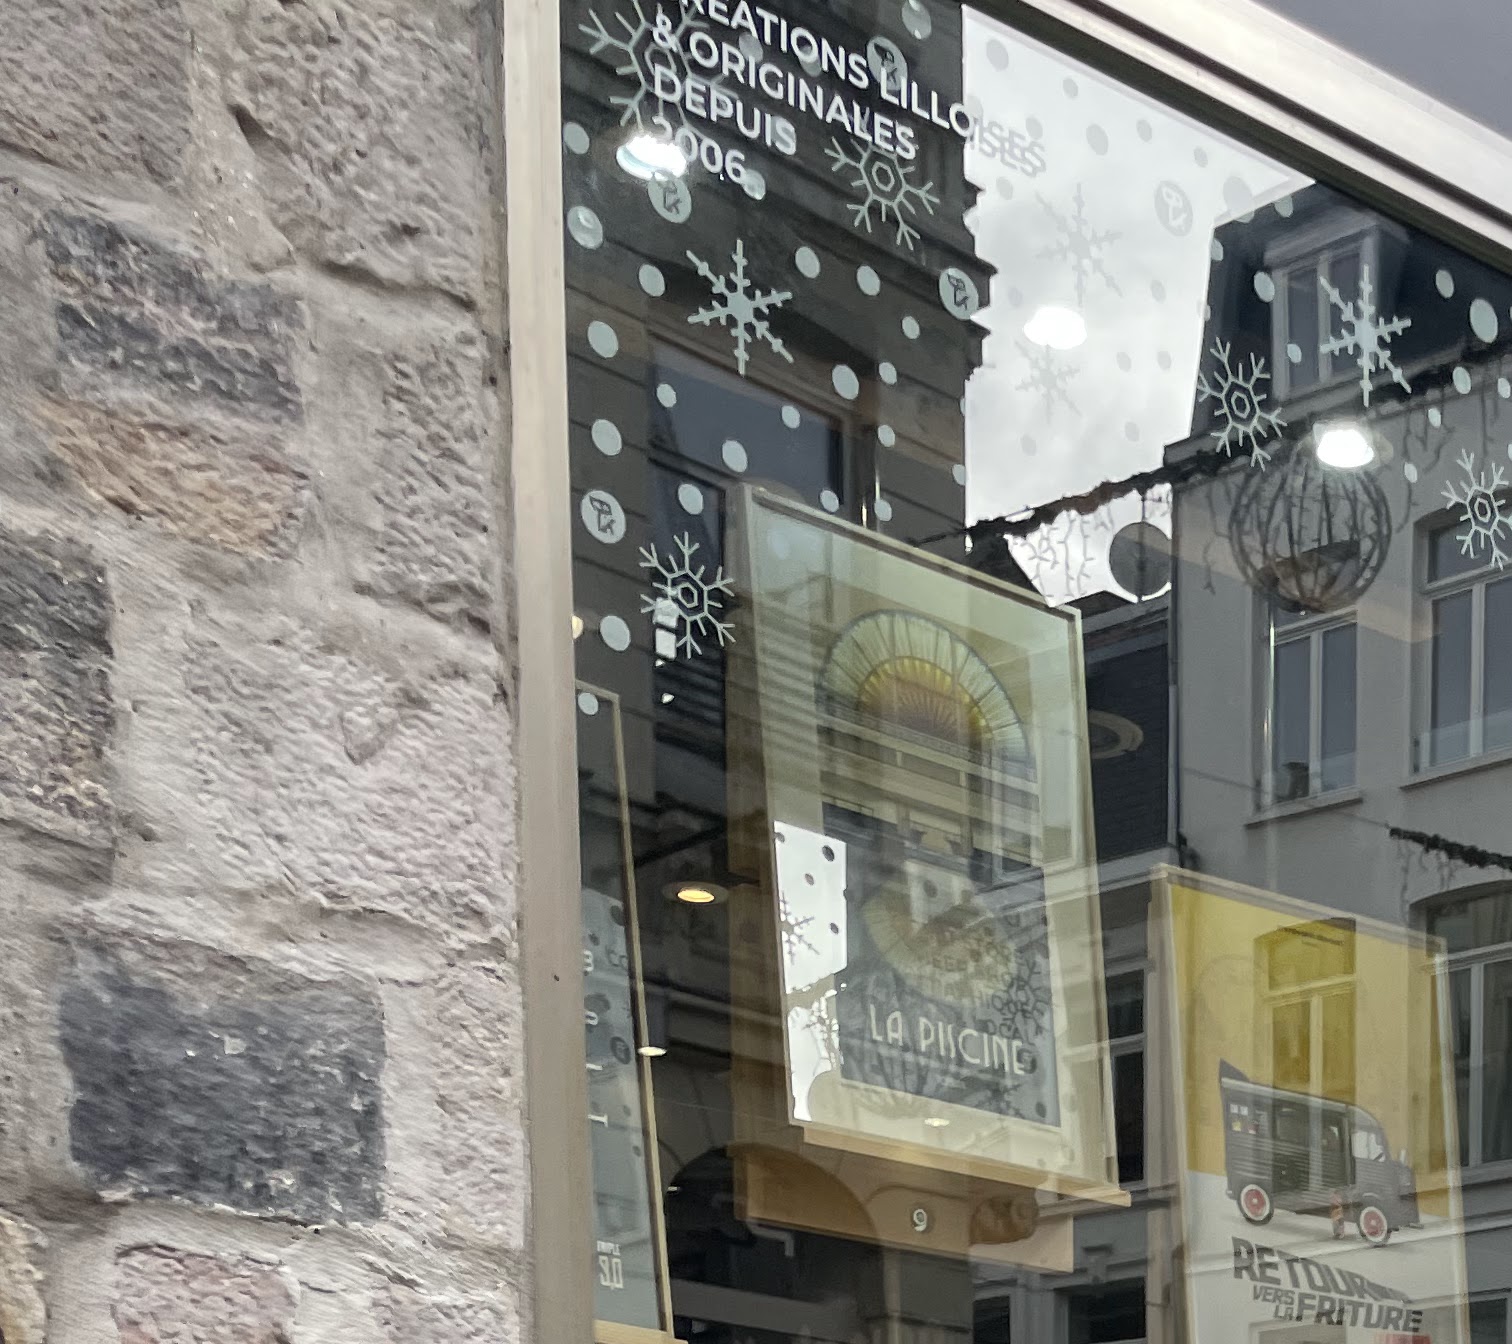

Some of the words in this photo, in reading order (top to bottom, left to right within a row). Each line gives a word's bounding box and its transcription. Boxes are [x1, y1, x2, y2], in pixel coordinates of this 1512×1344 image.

[652, 11, 680, 53] &
[689, 31, 916, 160] ORIGINALES
[654, 62, 797, 156] DEPUIS
[870, 1003, 903, 1047] LA
[919, 1016, 1025, 1076] PISCINE
[1232, 1236, 1384, 1302] RETOUR
[1253, 1284, 1296, 1306] VERS
[1296, 1292, 1423, 1333] FRITURE
[1274, 1303, 1292, 1322] LA
